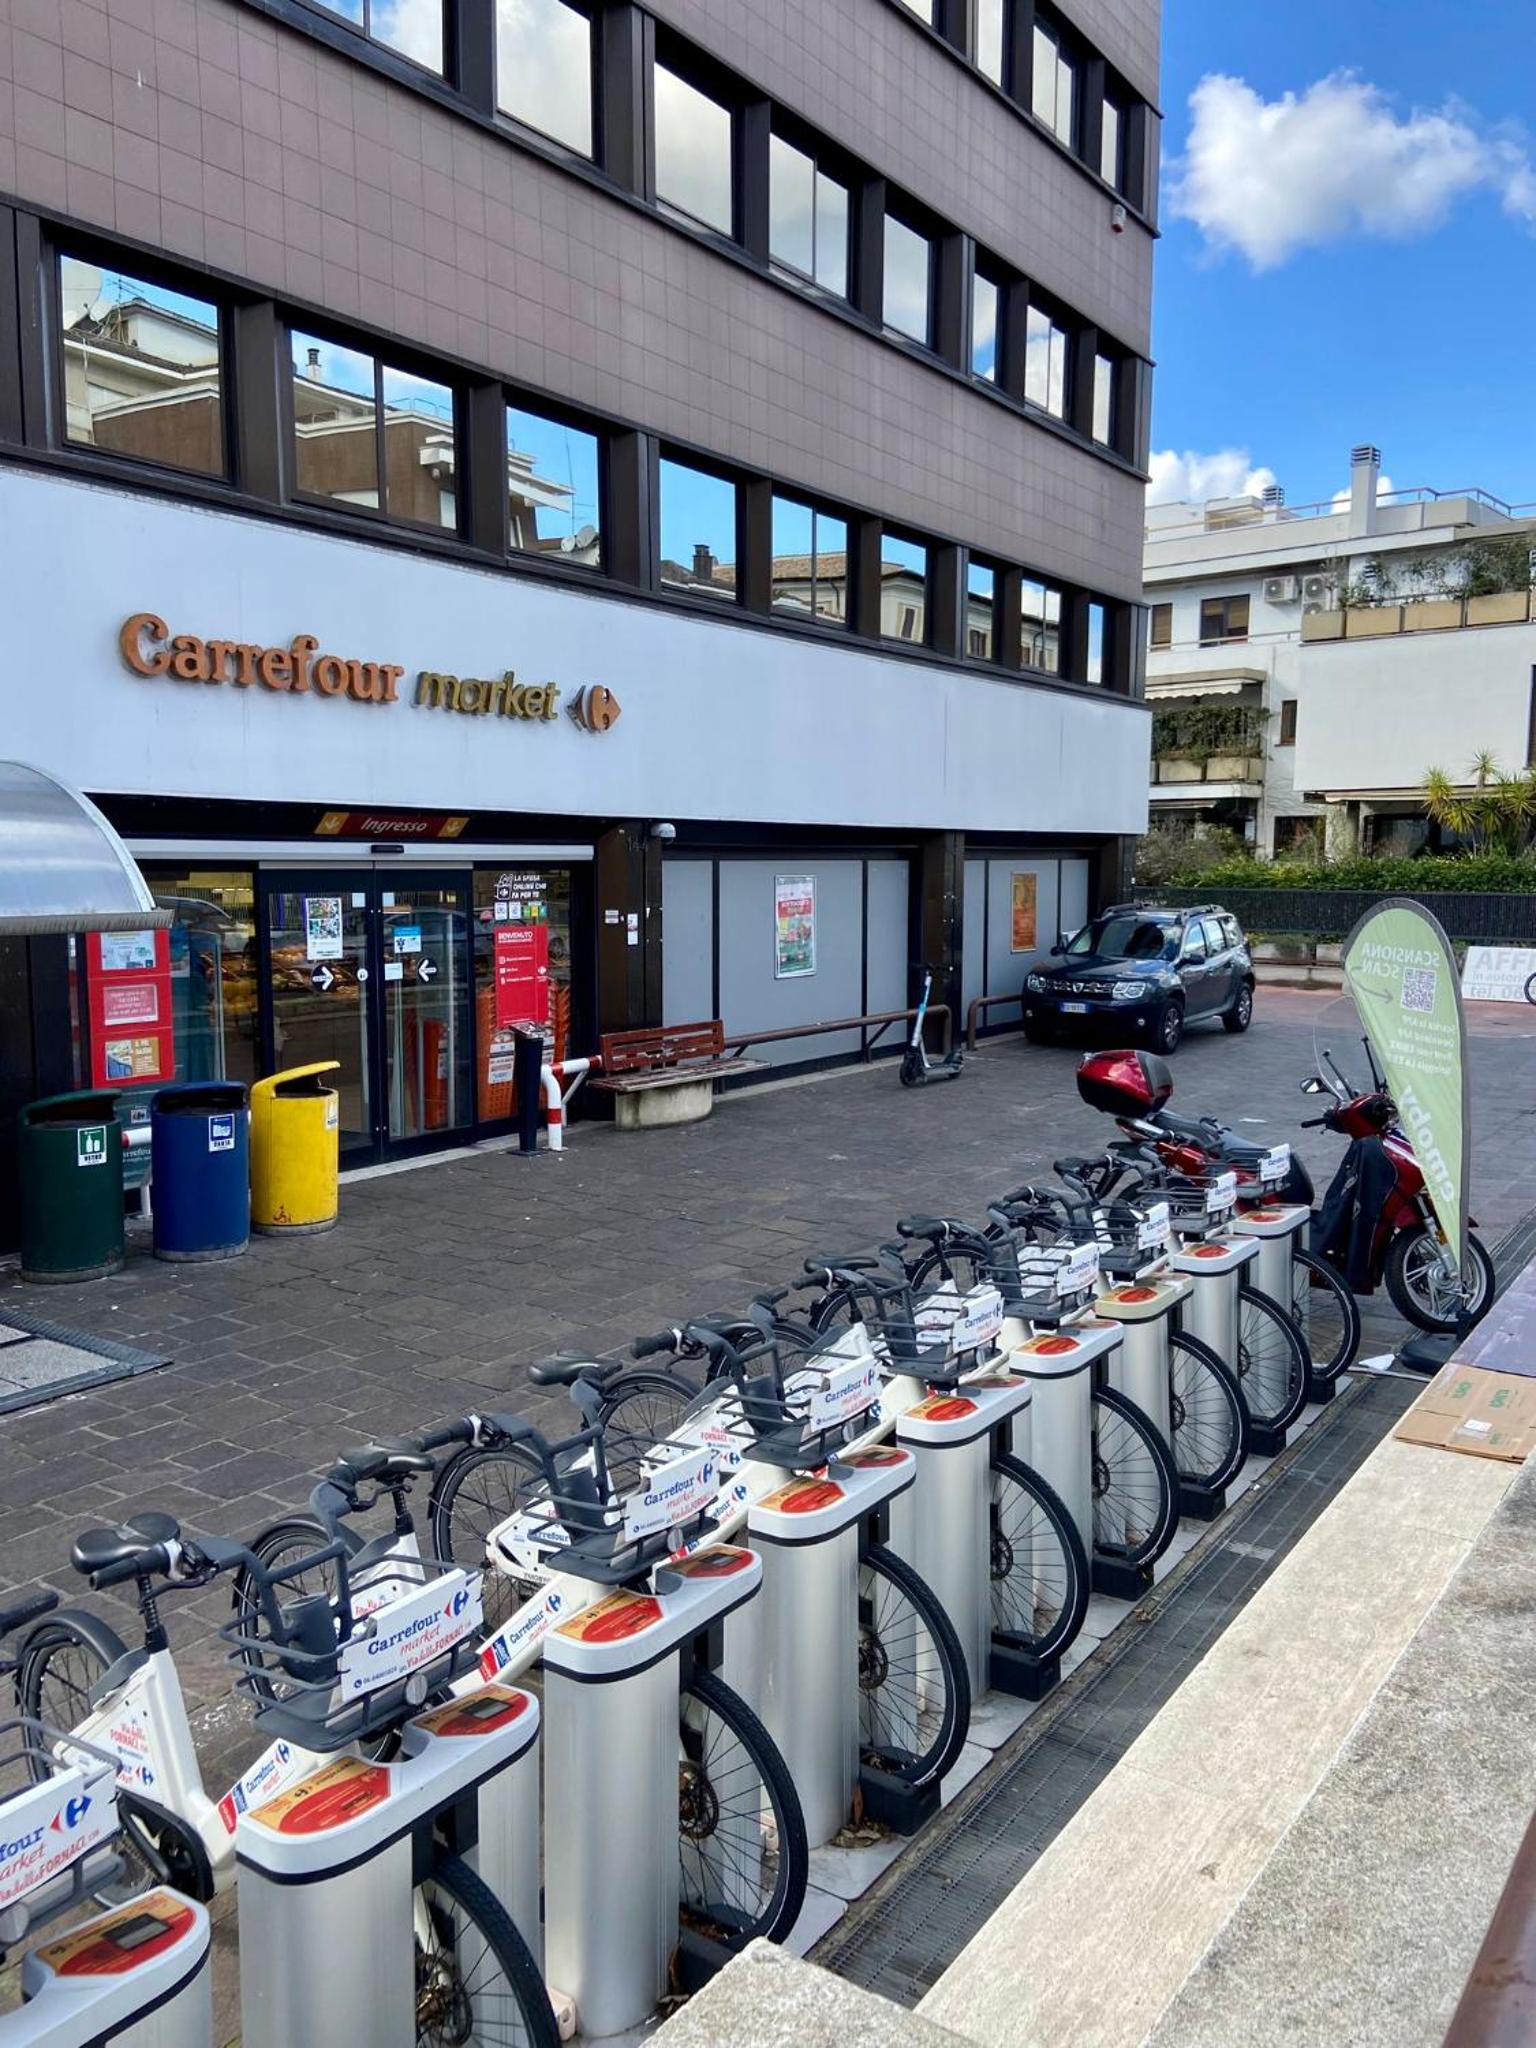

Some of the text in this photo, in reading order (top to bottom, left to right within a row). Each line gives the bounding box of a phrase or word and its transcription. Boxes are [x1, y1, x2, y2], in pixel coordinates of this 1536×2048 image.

[119, 612, 560, 722] Carrefour market
[360, 818, 428, 834] Ingresso
[644, 1477, 695, 1506] Carrefour
[534, 1530, 570, 1543] rrefour
[367, 1610, 441, 1656] Carrefour
[400, 1624, 441, 1655] market
[510, 1609, 544, 1645] Carrefour
[0, 1843, 44, 1881] arket
